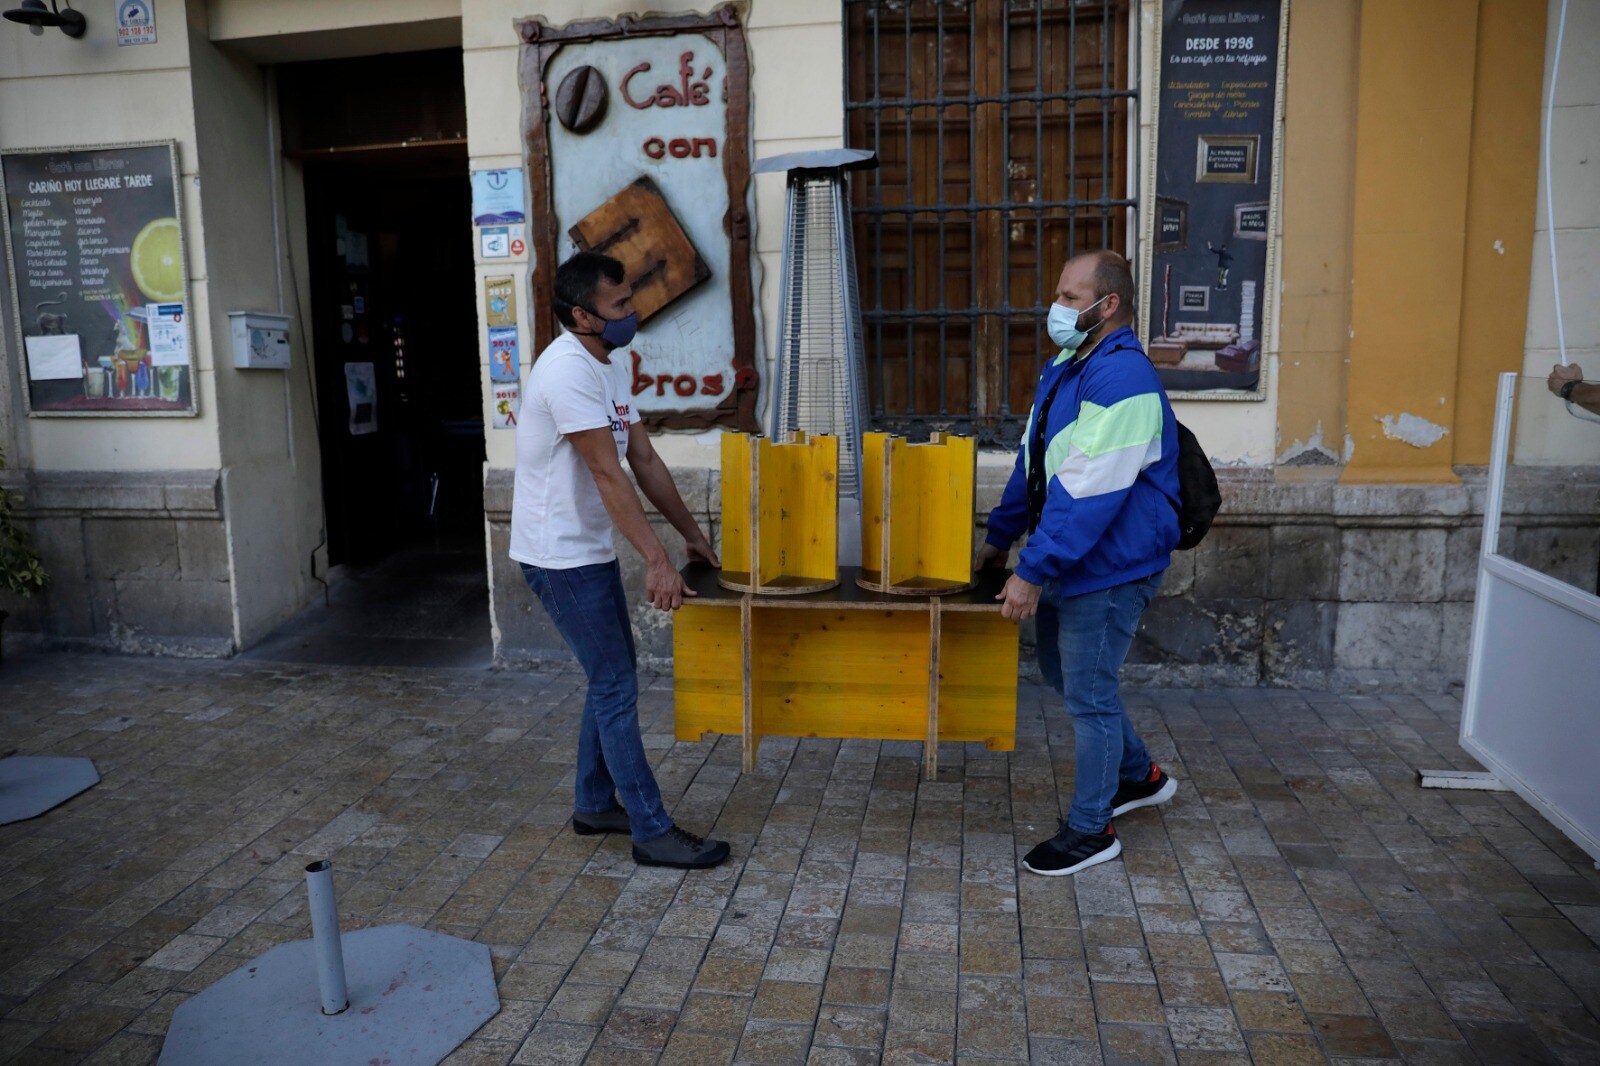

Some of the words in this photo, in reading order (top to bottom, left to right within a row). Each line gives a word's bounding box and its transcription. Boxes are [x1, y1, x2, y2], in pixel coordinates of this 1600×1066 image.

[1186, 37, 1220, 50] DESDE
[1224, 36, 1254, 50] 1998
[1170, 54, 1180, 64] Es
[1226, 54, 1235, 63] tu
[1236, 54, 1267, 66] refugio
[620, 51, 713, 110] Café
[643, 137, 716, 159] con
[28, 179, 62, 194] CARIÑO
[64, 179, 82, 192] HOY
[85, 174, 121, 190] LLEGARÉ
[124, 174, 153, 188] TARDE
[630, 350, 724, 397] bros
